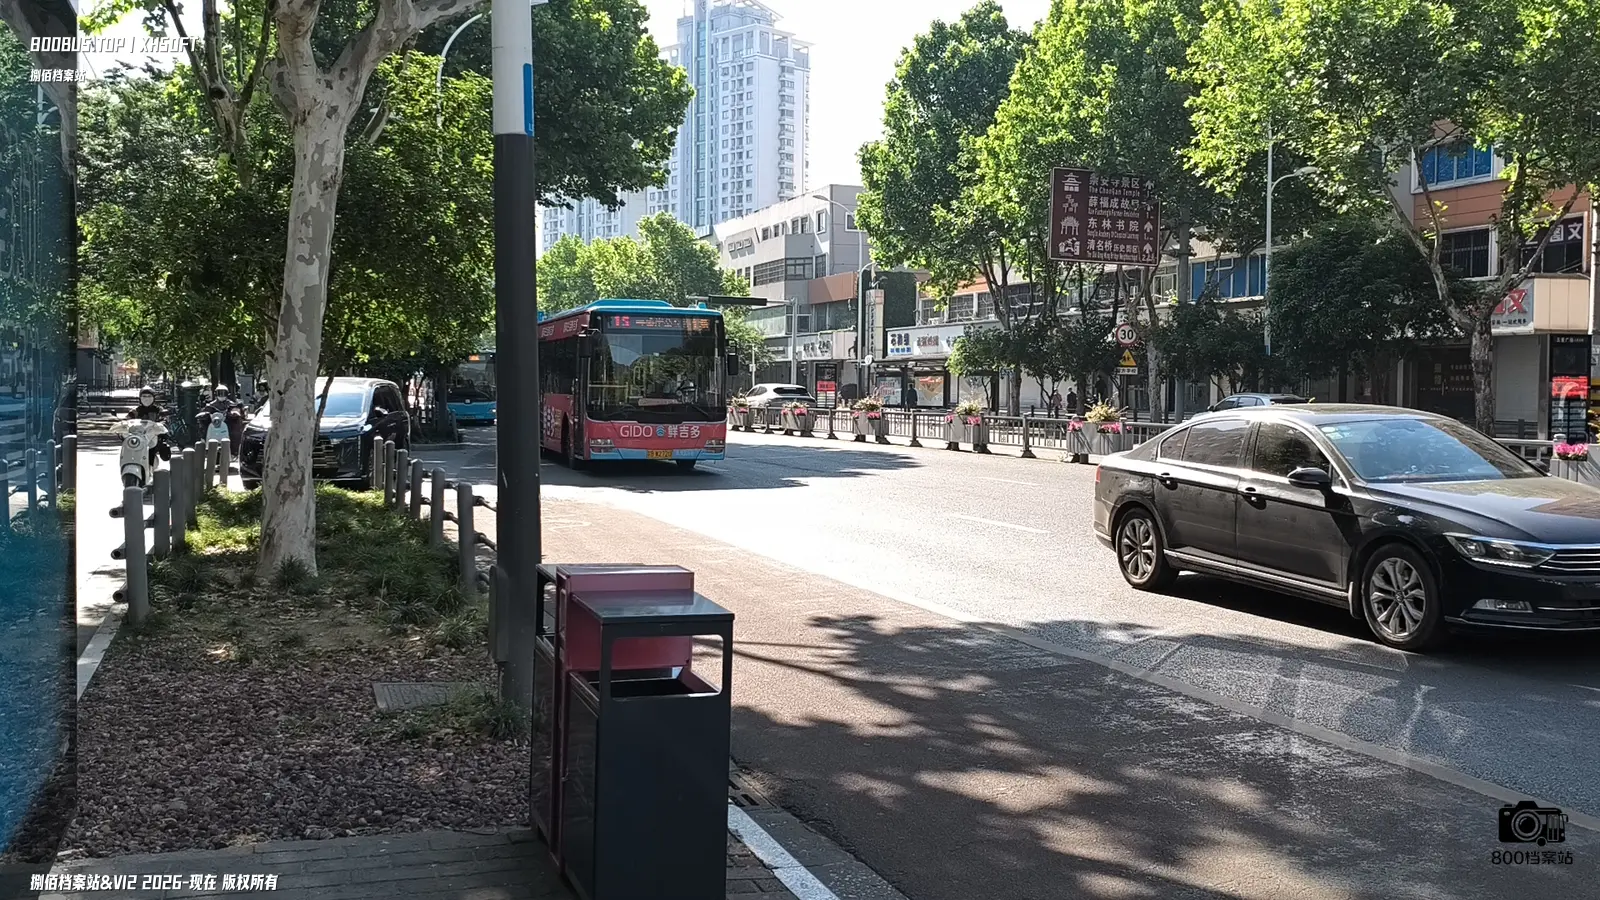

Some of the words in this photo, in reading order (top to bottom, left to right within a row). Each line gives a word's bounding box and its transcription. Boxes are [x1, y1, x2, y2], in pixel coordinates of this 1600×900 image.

[1087, 217, 1140, 232] 东林书院
[1120, 329, 1134, 340] 30
[620, 425, 653, 438] GIDO
[668, 425, 701, 439] 鲜吉多
